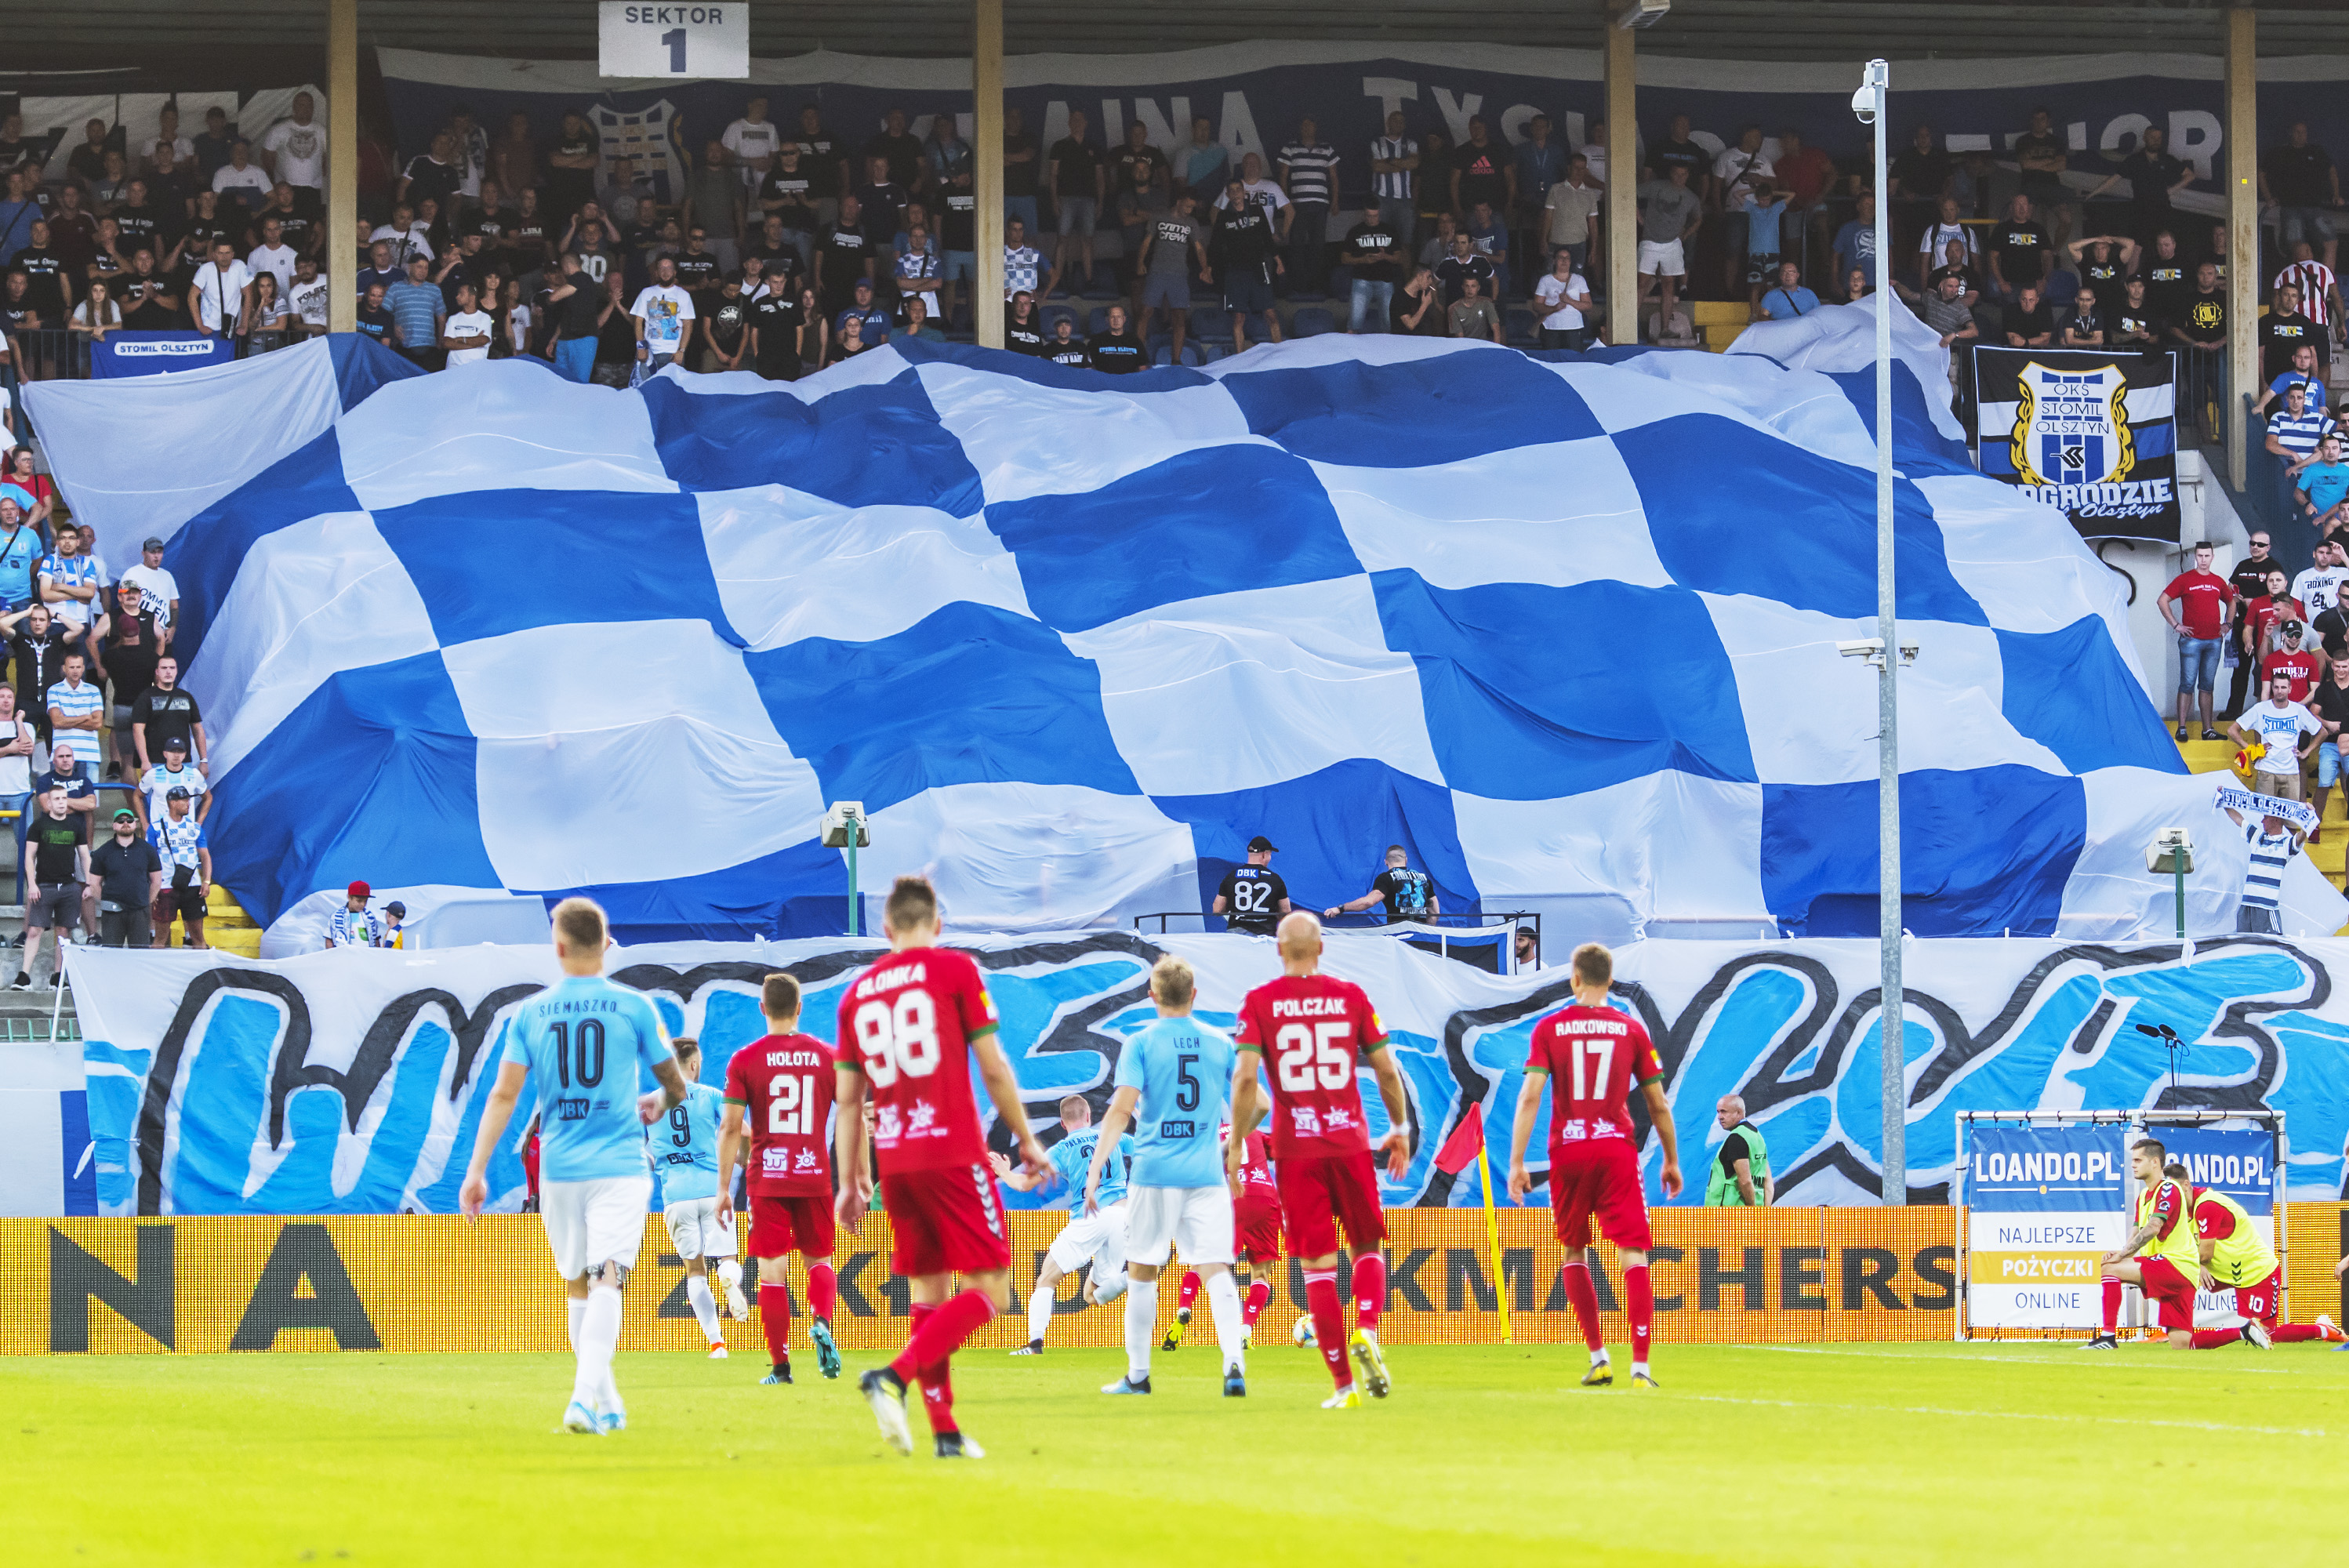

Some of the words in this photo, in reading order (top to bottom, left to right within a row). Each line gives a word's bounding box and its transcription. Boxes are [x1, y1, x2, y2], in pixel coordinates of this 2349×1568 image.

[625, 6, 724, 25] SEKTOR
[660, 28, 687, 73] 1
[1157, 222, 1191, 234] crime
[1159, 231, 1188, 243] crew
[296, 285, 327, 304] POLSK
[120, 344, 158, 353] STOMIL
[160, 342, 209, 352] OLSZTYN
[2053, 383, 2089, 397] OKS
[2041, 402, 2104, 416] STOMIL
[2035, 421, 2110, 435] OLSZTYN
[2079, 503, 2166, 519] Olsztyn
[140, 587, 168, 608] OMMY
[2264, 718, 2296, 731] STOMIL
[2224, 791, 2256, 807] STOMIL
[2258, 799, 2297, 815] OLSZTYN
[1236, 869, 1257, 877] DBK
[1234, 880, 1272, 913] 82
[539, 1000, 617, 1018] SIEMASZKO
[1273, 998, 1349, 1018] POLCZAK
[1555, 1021, 1628, 1036] RADKOWSKI
[853, 989, 941, 1089] 98
[1173, 1036, 1201, 1049] LECH
[549, 1018, 605, 1090] 10
[766, 1052, 820, 1067] HOŁOTA
[1276, 1022, 1352, 1092] 25
[1571, 1040, 1617, 1101] 17
[1176, 1054, 1200, 1112] 5
[768, 1073, 815, 1135] 21
[669, 1105, 692, 1148] 9
[1163, 1123, 1193, 1137] DBK
[1975, 1151, 2122, 1182] LOANDO.PL
[1999, 1227, 2096, 1244] NAJLEPSZE
[2002, 1254, 2093, 1277] POŻYCZKI
[2015, 1291, 2080, 1309] ONLINE
[2194, 1294, 2238, 1312] NLINE
[2249, 1294, 2264, 1314] 10
